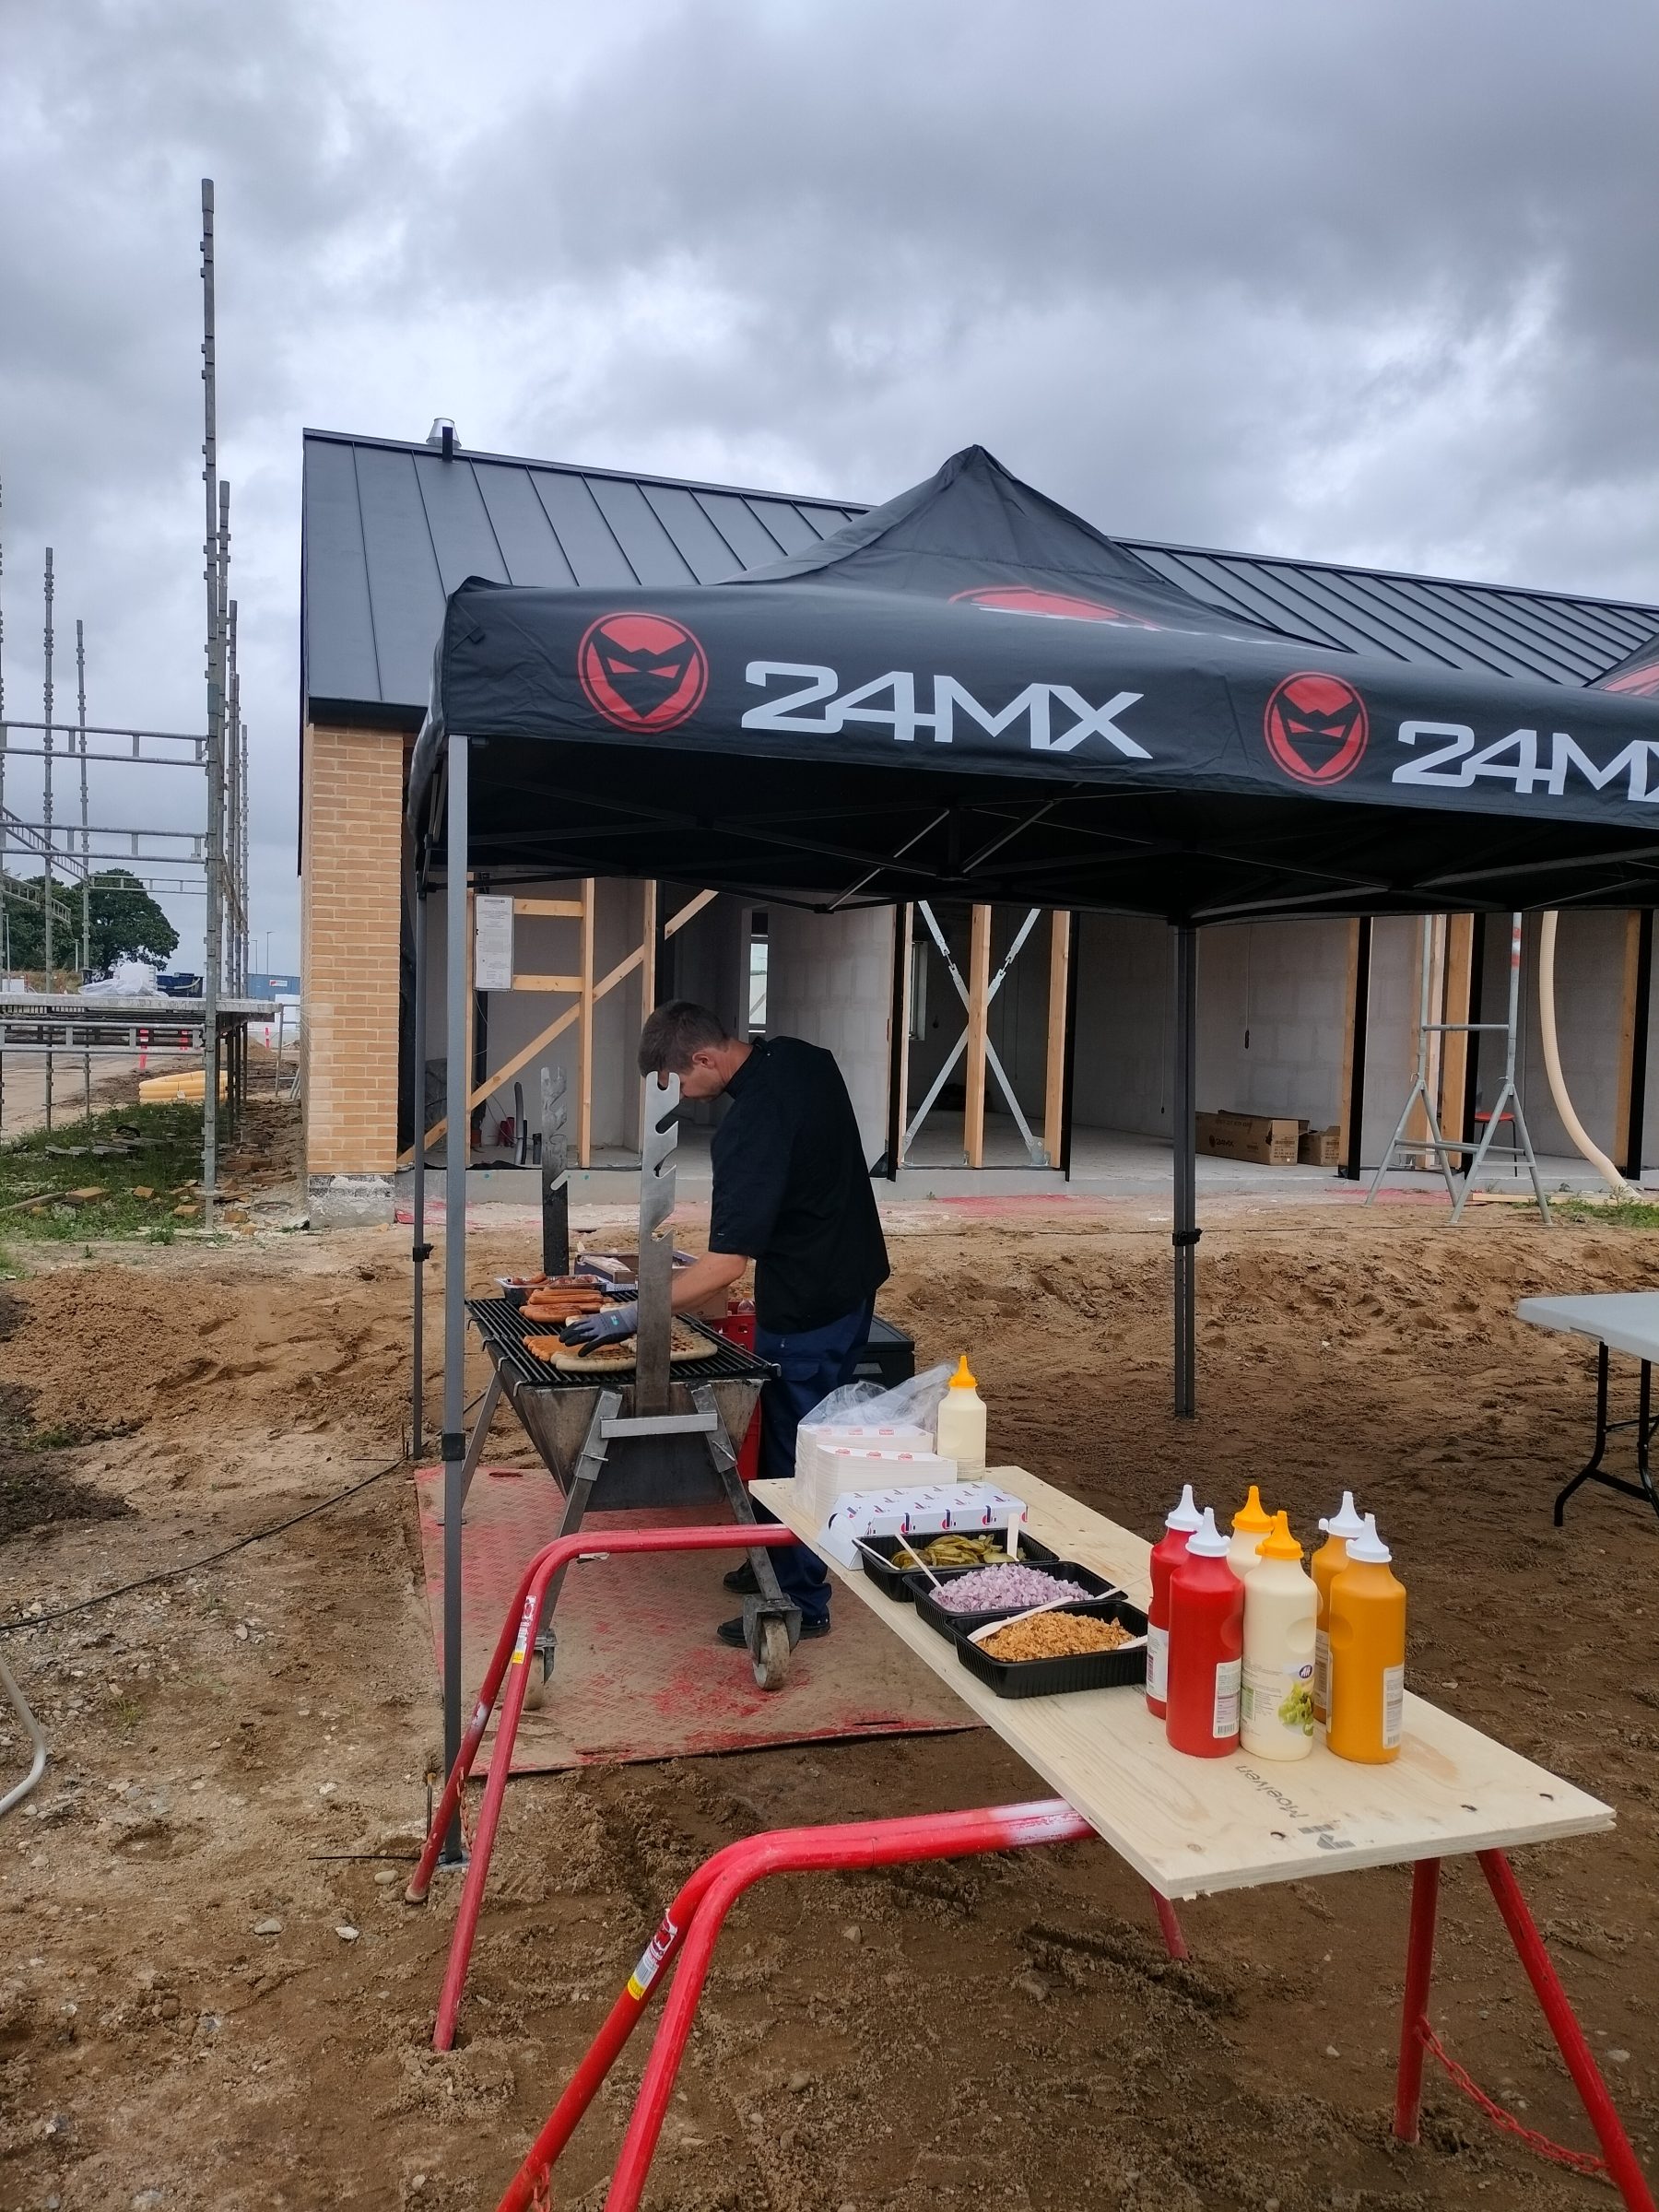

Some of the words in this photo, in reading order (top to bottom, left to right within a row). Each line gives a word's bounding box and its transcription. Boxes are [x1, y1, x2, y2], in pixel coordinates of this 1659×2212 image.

[741, 660, 1153, 759] 24MX
[1392, 721, 1659, 802] 24M
[1235, 1765, 1309, 1818] Moelven
